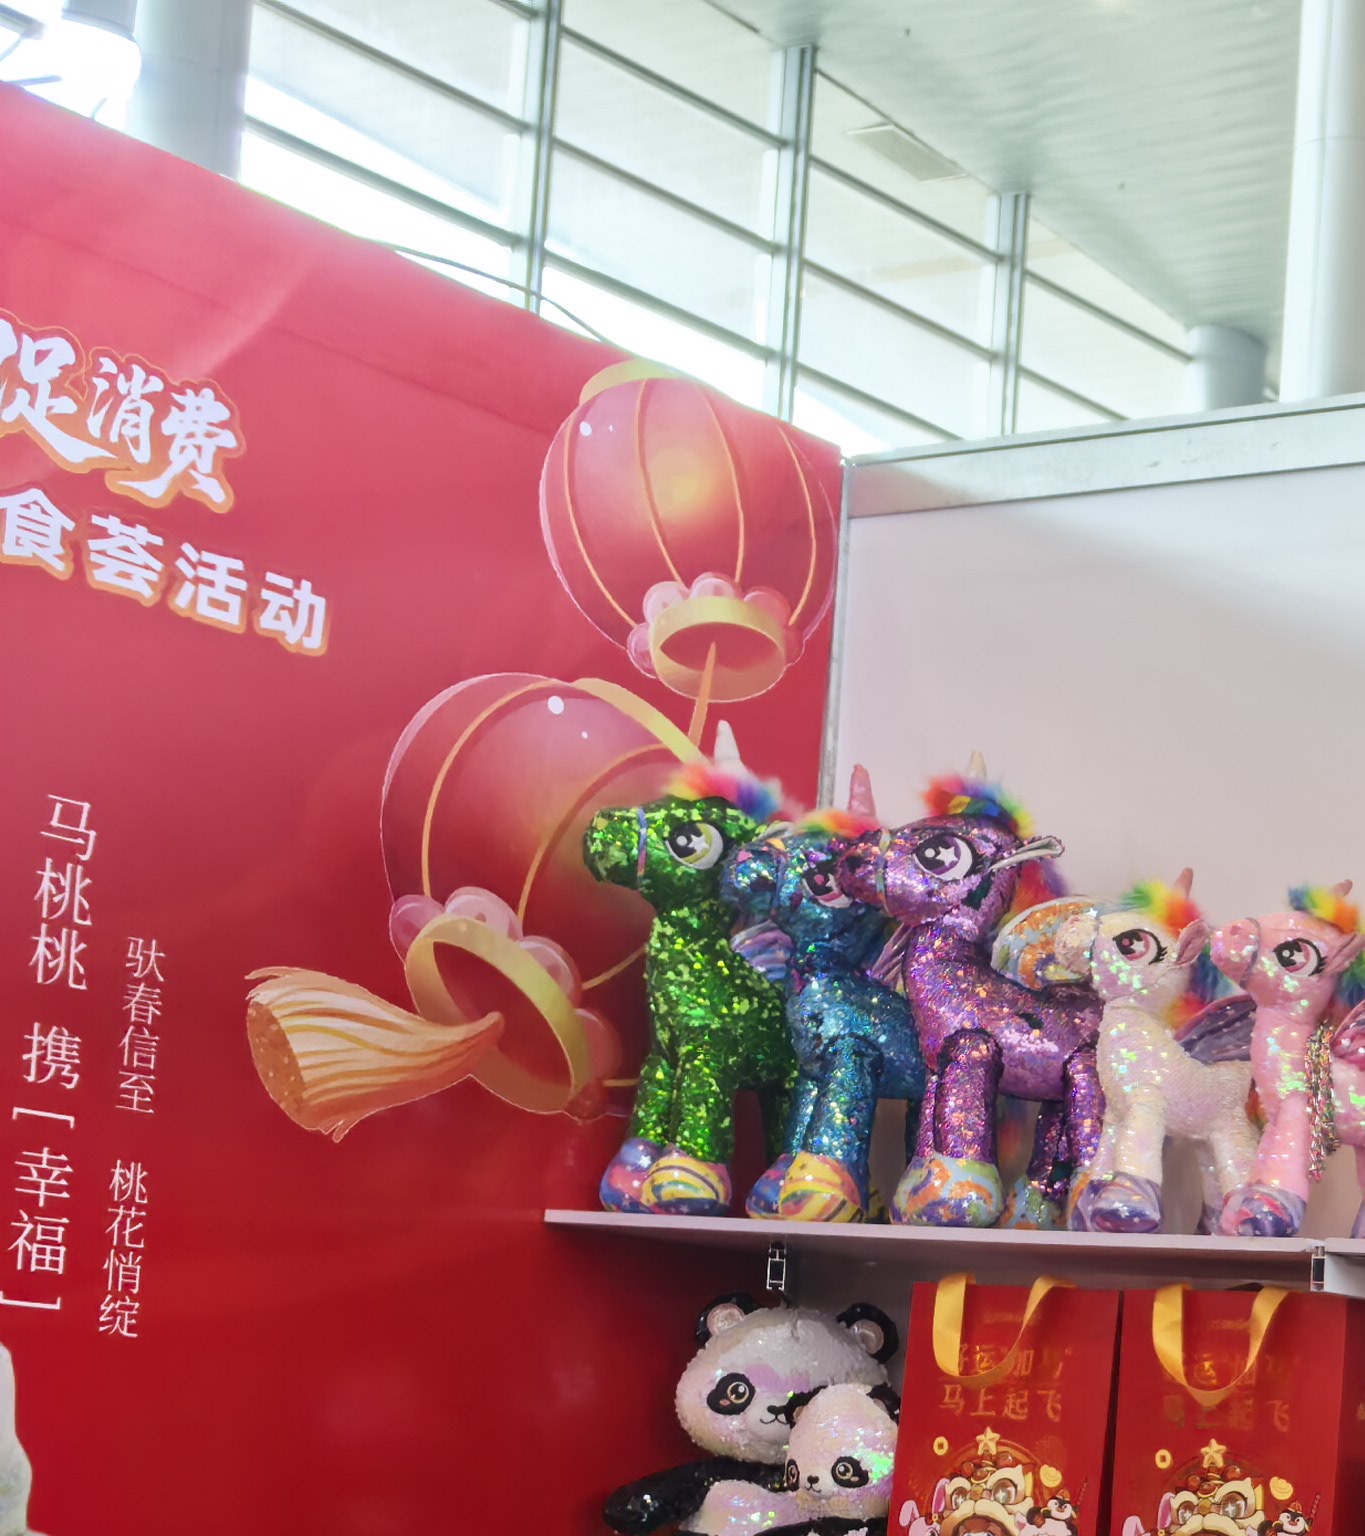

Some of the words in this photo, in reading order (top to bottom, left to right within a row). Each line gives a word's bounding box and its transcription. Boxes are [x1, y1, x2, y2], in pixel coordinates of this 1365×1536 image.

[0, 488, 327, 649] 食荟活动
[29, 794, 97, 991] 马桃桃
[22, 1021, 82, 1090] 携
[115, 936, 166, 1114] 驮春信至
[98, 1159, 149, 1338] 桃花悄绽
[938, 1384, 1062, 1423] 马上起飞
